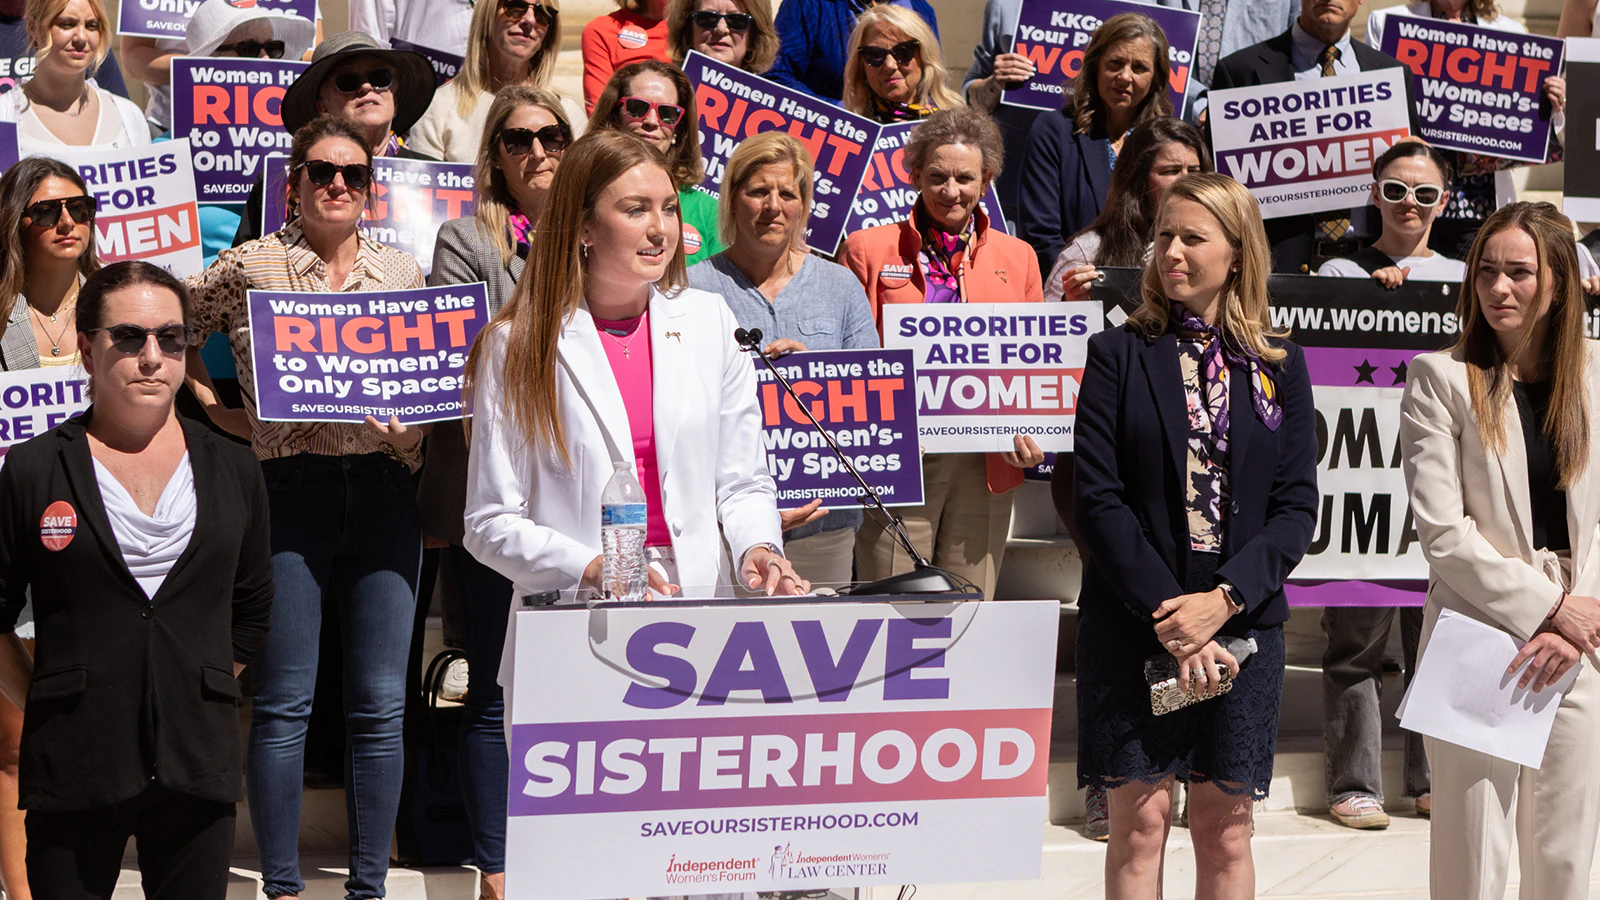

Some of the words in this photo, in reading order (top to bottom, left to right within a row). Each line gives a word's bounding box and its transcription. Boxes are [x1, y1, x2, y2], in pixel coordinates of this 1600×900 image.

[1019, 24, 1069, 45] Your
[1398, 21, 1469, 47] Women
[1472, 33, 1518, 54] Have
[1522, 41, 1554, 60] the
[190, 67, 273, 84] Women
[430, 57, 456, 76] ave
[1395, 37, 1550, 94] RIGHT
[193, 85, 287, 126] RIG
[701, 66, 776, 108] Women
[778, 97, 830, 128] Have
[833, 119, 868, 142] the
[1223, 81, 1392, 120] SORORITIES
[695, 82, 863, 177] RIGHT
[1248, 118, 1307, 143] ARE
[1316, 110, 1373, 134] FOR
[1449, 103, 1534, 133] Spaces
[189, 127, 220, 147] to
[78, 153, 177, 186] RITIES
[193, 150, 260, 176] Only
[376, 167, 432, 186] Have
[437, 171, 475, 188] the
[883, 264, 910, 273] SAVE
[269, 299, 362, 316] Women
[369, 299, 429, 315] Have
[434, 294, 476, 310] the
[273, 309, 476, 354] RIGHT
[899, 314, 1088, 338] SORORITIES
[273, 354, 307, 371] to
[925, 343, 990, 365] ARE
[1000, 343, 1063, 364] FOR
[808, 361, 863, 378] Have
[867, 358, 904, 376] the
[2, 379, 87, 409] ORIT
[279, 374, 353, 398] Only
[292, 402, 467, 416] SAVEOURSISTERHOOD.COM
[919, 425, 1072, 437] SAVEOURSISTERHOOD.COM
[43, 516, 72, 527] SAVE
[622, 617, 953, 710] SAVE
[522, 727, 1036, 798] SISTERHOOD
[640, 812, 919, 837] SAVEOURSISTERHOOD.COM
[665, 853, 757, 873] Independent
[796, 851, 851, 864] Independent
[852, 852, 889, 862] Women's
[665, 872, 718, 885] Women's
[719, 870, 756, 882] Forum
[787, 865, 822, 879] LAW
[825, 863, 887, 877] CENTER
